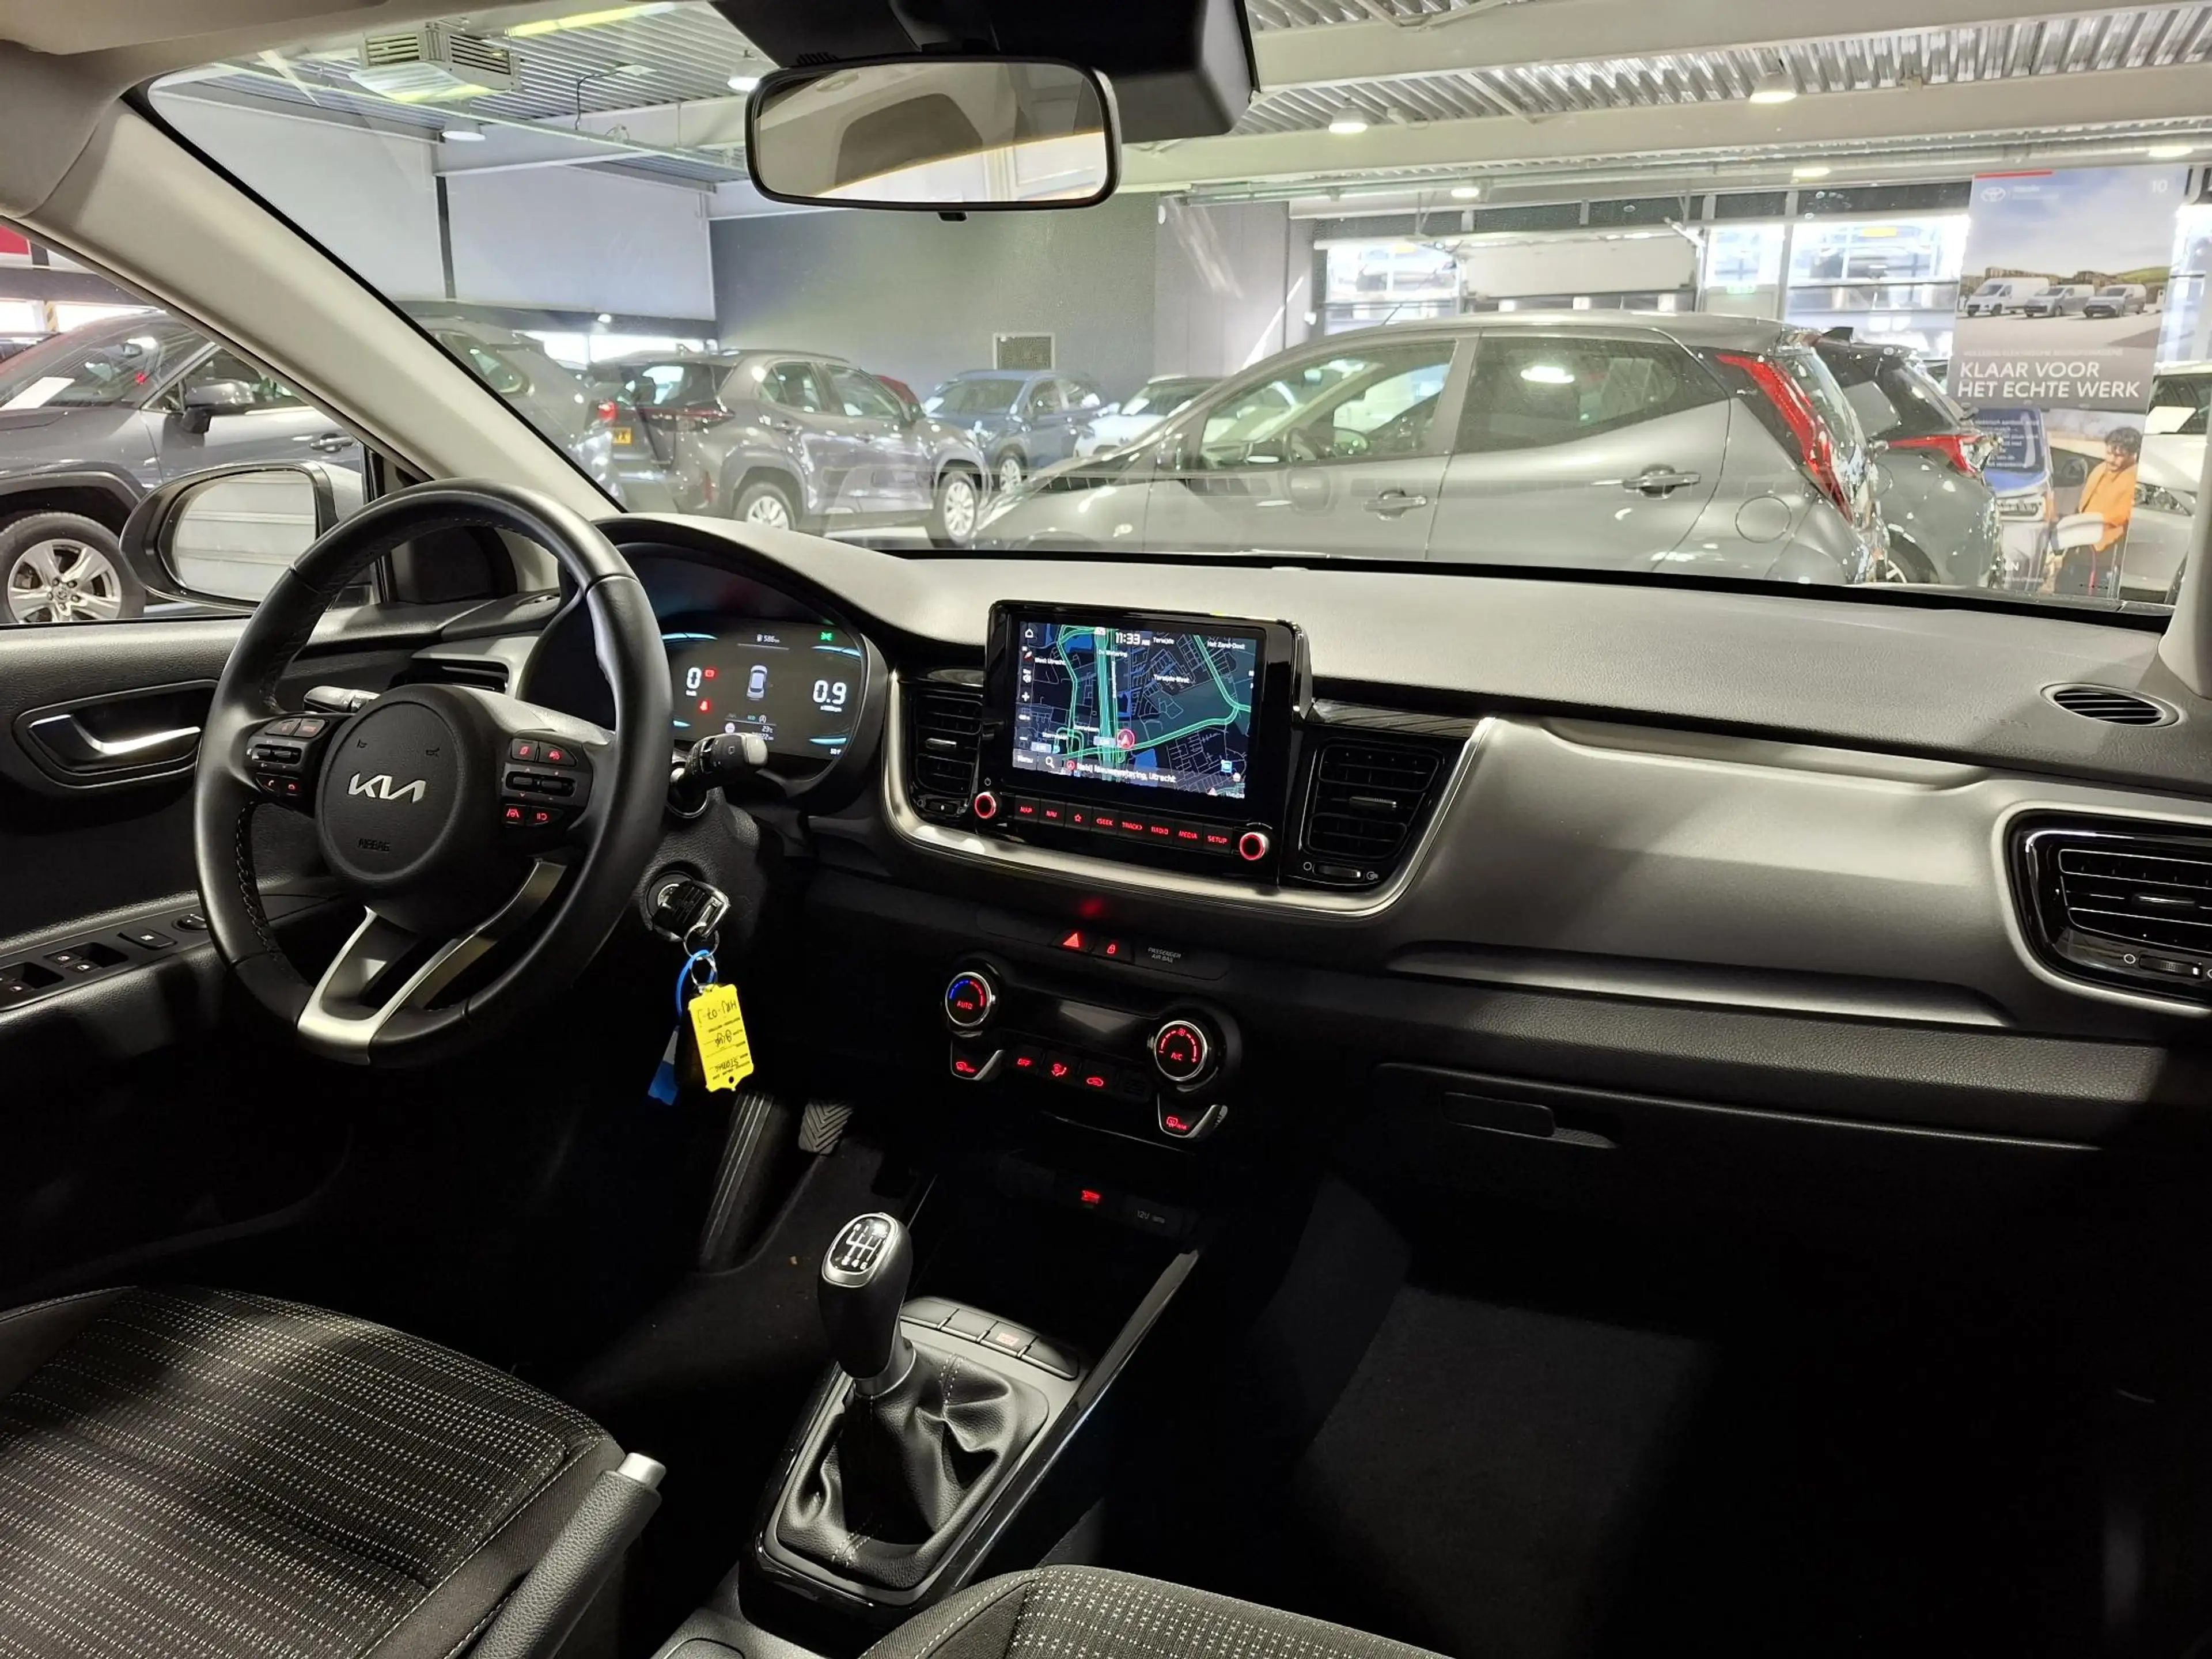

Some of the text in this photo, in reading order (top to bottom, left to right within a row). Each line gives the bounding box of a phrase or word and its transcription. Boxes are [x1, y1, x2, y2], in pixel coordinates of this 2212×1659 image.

[2151, 180, 2169, 193] 10
[1960, 361, 2100, 378] KLAAR VOOR
[1957, 381, 2141, 399] HET ECHTE WERK
[1115, 632, 1141, 646] 11:33
[686, 667, 702, 689] 0
[813, 680, 847, 705] 0.9
[348, 772, 427, 803] KIA
[1151, 826, 1169, 835] RADIO
[1207, 835, 1228, 844] SETUP
[956, 1000, 974, 1010] AUTO
